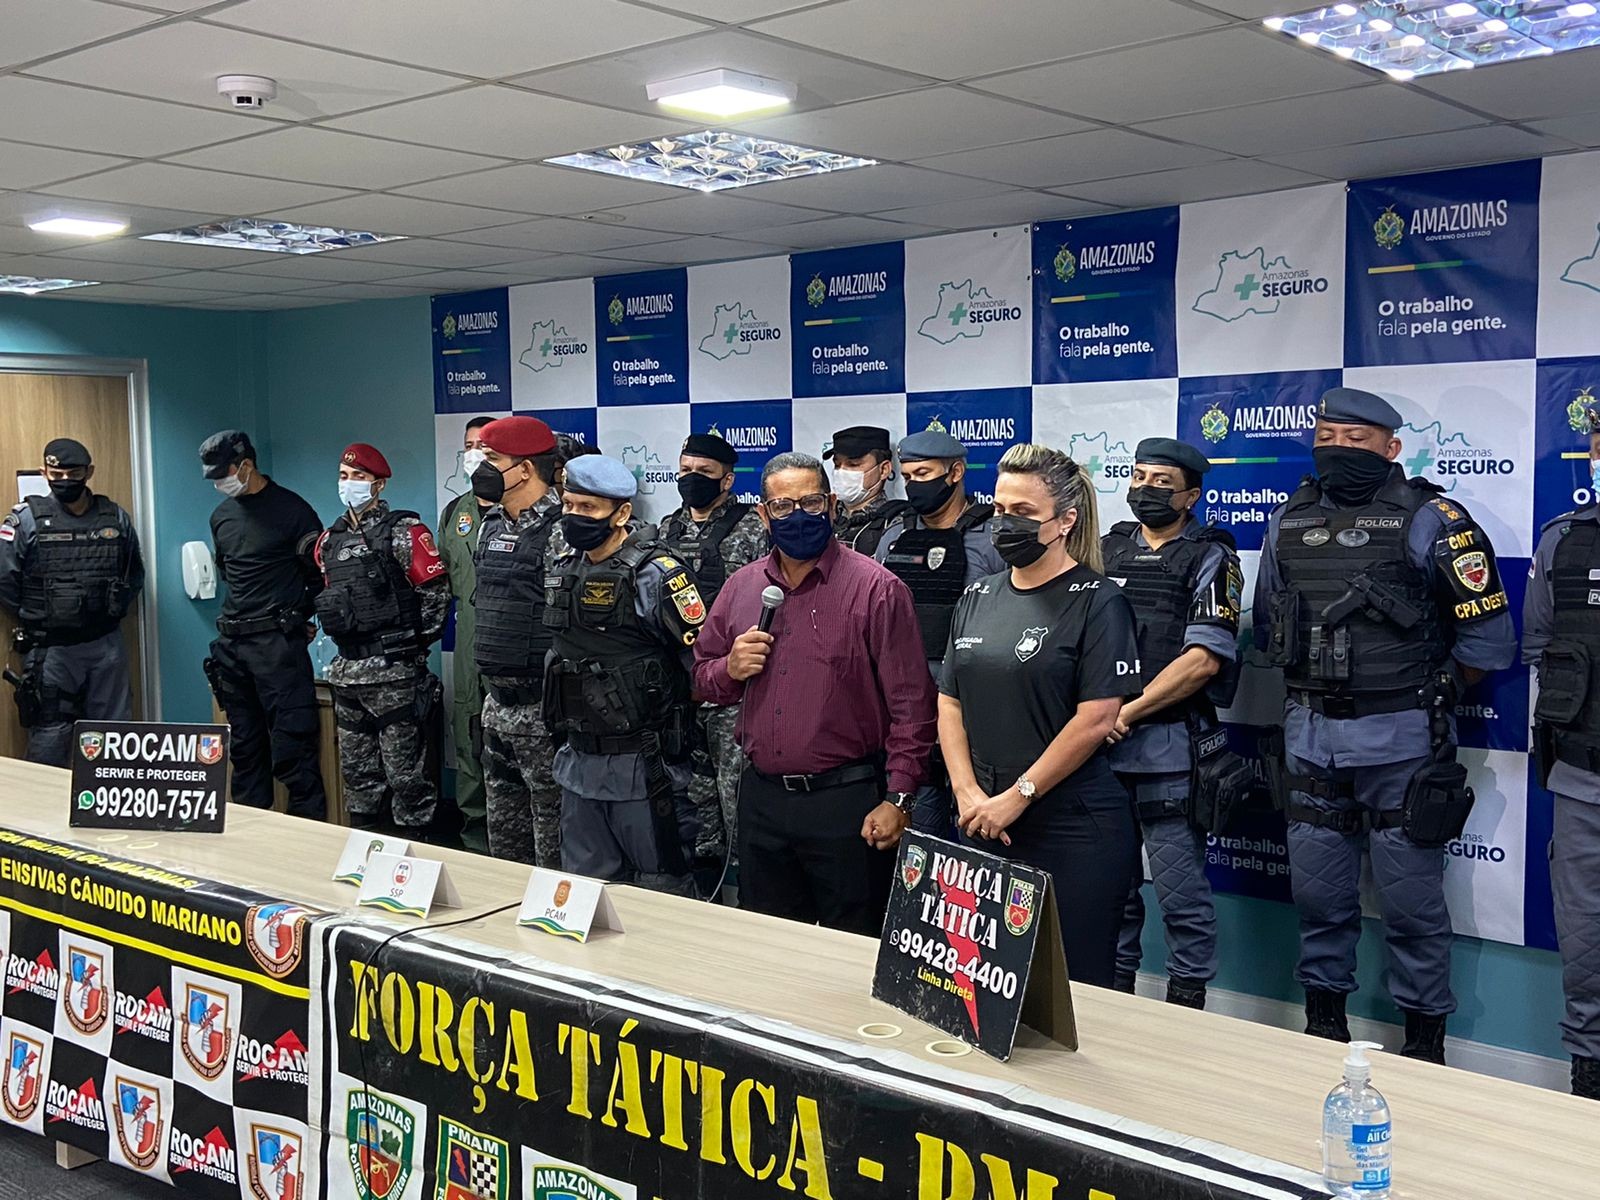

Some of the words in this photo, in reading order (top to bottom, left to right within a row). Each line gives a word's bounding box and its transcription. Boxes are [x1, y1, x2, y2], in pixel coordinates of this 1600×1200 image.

[1410, 199, 1508, 235] AMAZONAS
[1425, 234, 1456, 242] GOVERNO
[1467, 230, 1492, 238] ESTADO
[1080, 241, 1155, 270] AMAZONAS
[828, 272, 886, 296] AMAZONAS
[1262, 268, 1309, 282] Amazonas
[1262, 278, 1328, 298] SEGURO
[626, 294, 673, 316] AMAZONAS
[968, 298, 1006, 309] Amazonas
[1378, 300, 1394, 316] O
[1398, 296, 1473, 315] trabalho
[458, 311, 498, 331] AMAZONAS
[969, 306, 1022, 324] SEGURO
[740, 328, 781, 342] SEGURO
[1060, 326, 1072, 340] O
[1074, 323, 1130, 340] trabalho
[1378, 319, 1408, 337] fala
[1410, 318, 1448, 338] pela
[1451, 316, 1507, 336] gente.
[553, 343, 588, 356] SEGURO
[812, 346, 822, 359] O
[824, 344, 869, 358] trabalho
[1060, 342, 1081, 358] fala
[1082, 342, 1110, 360] pela
[1113, 341, 1154, 358] gente.
[613, 360, 621, 372] O
[622, 358, 660, 370] trabalho
[812, 360, 830, 374] fala
[832, 360, 854, 376] pela
[855, 360, 888, 374] gente.
[447, 372, 454, 382] O
[454, 370, 486, 382] trabalho
[614, 374, 628, 386] fala
[628, 374, 647, 386] pela
[648, 373, 676, 386] gente.
[460, 384, 476, 396] pela
[476, 383, 500, 396] gente.
[1233, 404, 1317, 432] AMAZONAS
[725, 427, 776, 446] AMAZONAS
[950, 418, 1014, 440] AMAZONAS
[1436, 448, 1493, 458] Amazonas
[1436, 459, 1514, 476] SEGURO
[1206, 489, 1219, 504] O
[1221, 488, 1289, 504] trabalho
[1572, 488, 1591, 506] O
[1231, 508, 1265, 526] pela
[1357, 518, 1400, 528] POLÍCIA
[1448, 530, 1474, 550] CMT
[669, 573, 689, 592] CMT
[1455, 600, 1481, 619] CPA
[1454, 704, 1499, 720] ente.
[104, 732, 197, 763] ROÇAM
[95, 767, 134, 779] SERVIR
[137, 769, 144, 780] E
[146, 768, 207, 782] PROTEGER
[95, 786, 218, 821] 99280-7574
[1220, 836, 1286, 856] trabalho
[1444, 841, 1506, 863] EGURO
[1232, 856, 1264, 870] pela
[930, 850, 1003, 907] FORÇA
[0, 857, 67, 896] ENSIVAS
[70, 876, 146, 920] CÂNDIDO
[152, 899, 242, 946] MARIANO
[390, 888, 404, 898] SSP
[544, 908, 567, 922] PCAM
[920, 890, 998, 950] TÁTICA
[8, 953, 58, 990] ROCAM
[899, 928, 1018, 1000] 99428-4400
[6, 975, 26, 988] SERVIR
[26, 983, 30, 992] E
[30, 984, 57, 1001] PROTEGER
[916, 966, 942, 988] Linha
[944, 980, 973, 1002] Direta
[116, 991, 172, 1031] ROCAM
[115, 1014, 132, 1030] SERVIR
[133, 1023, 138, 1032] E
[138, 1024, 170, 1043] PROTEGER
[237, 1034, 308, 1074] ROCAM
[236, 1060, 260, 1077] SERVIR
[262, 1067, 268, 1079] E
[270, 1070, 308, 1086] PROTEGE
[349, 959, 539, 1115] FORÇA
[557, 1018, 834, 1200] TÁTICA
[858, 1156, 884, 1182] -
[47, 1080, 104, 1121] ROCAM
[46, 1104, 66, 1120] SERVIR
[66, 1112, 71, 1122] E
[71, 1112, 106, 1132] PROTEGER
[350, 1093, 412, 1134] AMAZONAS
[448, 1124, 500, 1156] PMAM
[1367, 1131, 1380, 1142] All
[170, 1126, 235, 1174] ROCAM
[170, 1152, 192, 1170] SERVIR
[194, 1161, 199, 1172] E
[200, 1163, 236, 1185] PROTEGER
[536, 1170, 622, 1200] AMAZONA
